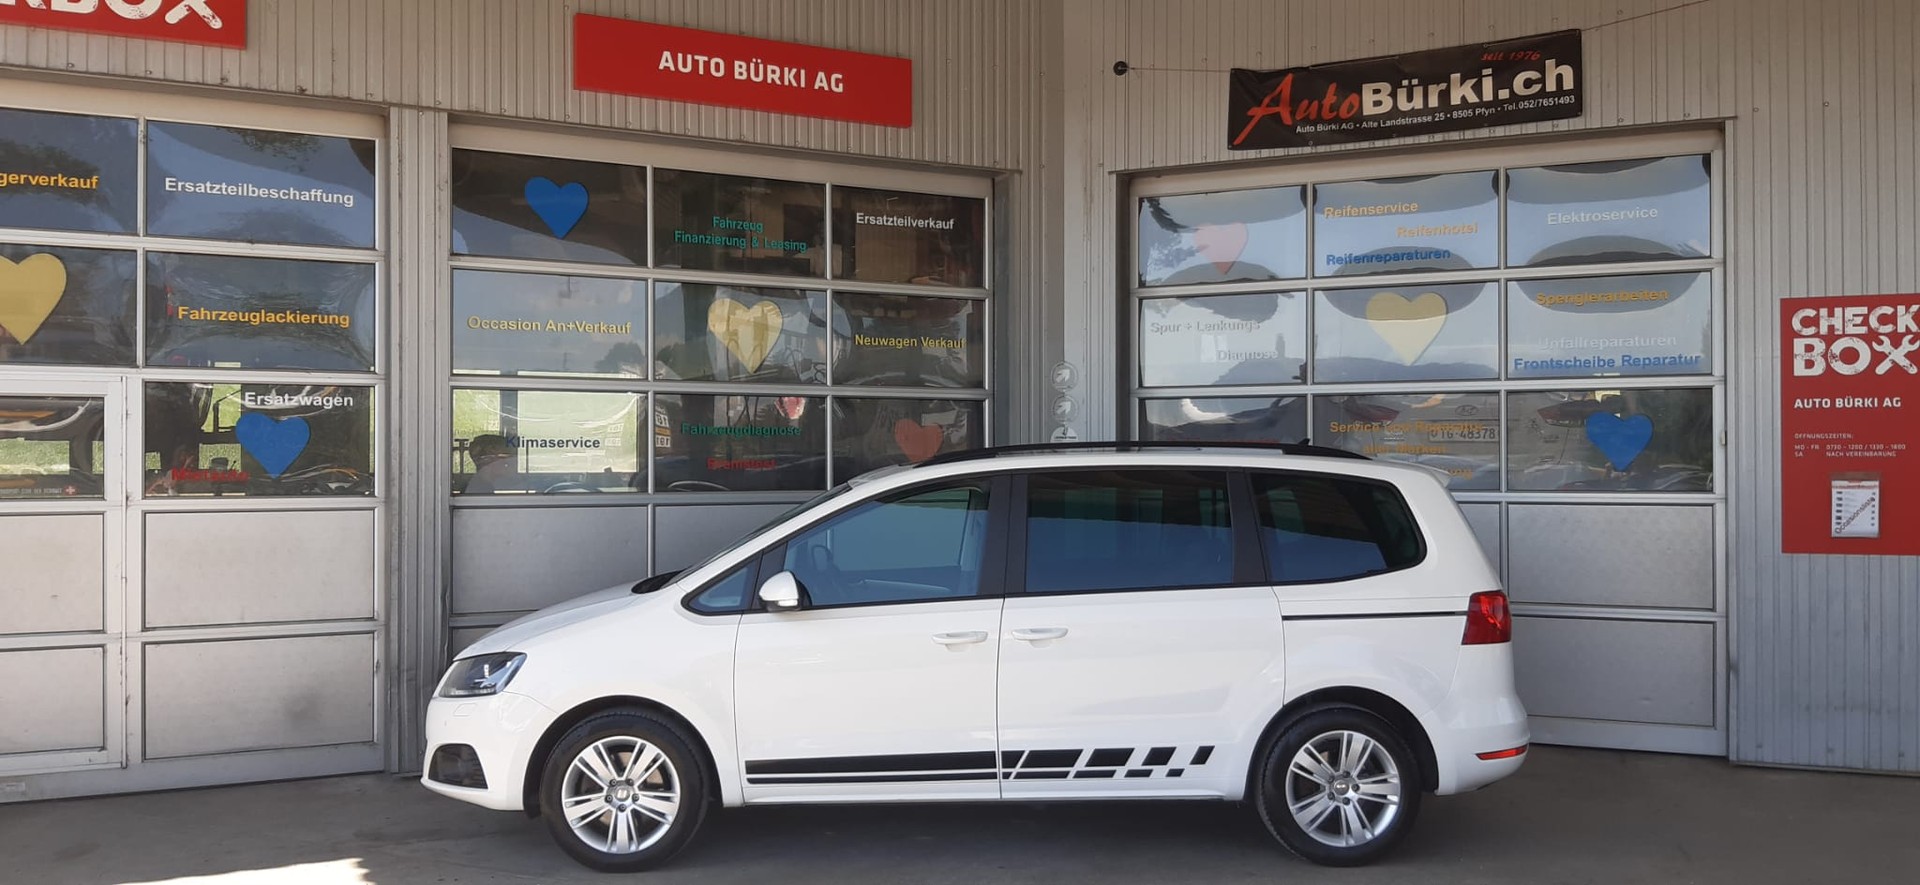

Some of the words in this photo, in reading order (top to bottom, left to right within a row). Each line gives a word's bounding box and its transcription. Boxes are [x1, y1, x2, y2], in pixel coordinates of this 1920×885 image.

[1510, 50, 1541, 60] 1976
[658, 51, 725, 77] AUTO
[733, 58, 806, 88] BÜRKI
[814, 72, 844, 93] AG
[1296, 125, 1315, 134] Auto
[1317, 122, 1339, 132] Bürki
[1341, 121, 1354, 130] AG
[1361, 120, 1378, 129] Alte
[1380, 114, 1432, 127] Landstrasse
[1434, 112, 1445, 121] 25
[1452, 109, 1474, 119] 8505
[1475, 106, 1496, 118] Pfyn
[164, 177, 354, 207] Ersatzteilbeschaffung
[1324, 202, 1419, 219] Reifenservice
[1547, 206, 1658, 225] Elektroservice
[712, 216, 764, 232] Fahrzeug
[855, 212, 954, 230] Ersatzteilverkauf
[1397, 222, 1478, 238] Reifenhotel
[674, 231, 747, 250] Finanzierung
[751, 238, 759, 248] &
[764, 237, 807, 253] Leasing
[1326, 249, 1451, 266] Reifenreparaturen
[1536, 289, 1669, 307] Spenglerarbeiten
[177, 305, 350, 329] Fahrzeuglackierung
[467, 315, 540, 332] Occasion
[545, 320, 632, 335] An+Verkauf
[1791, 304, 1920, 336] CHECK
[1151, 321, 1181, 336] Spur
[855, 334, 918, 350] Neuwagen
[921, 336, 966, 349] Verkauf
[1537, 335, 1677, 351] Unfallreparaturen
[1217, 349, 1278, 363] Diagnose
[1514, 356, 1615, 371] Frontscheibe
[1621, 354, 1700, 370] Reparatur
[244, 391, 353, 410] Ersatzwagen
[1794, 398, 1831, 409] AUTO
[1835, 395, 1878, 408] BÜRKI
[1882, 396, 1902, 408] AG
[681, 422, 802, 438] Fahrzeugdiagnose
[1329, 422, 1380, 433] Service
[506, 436, 601, 450] Klimaservice
